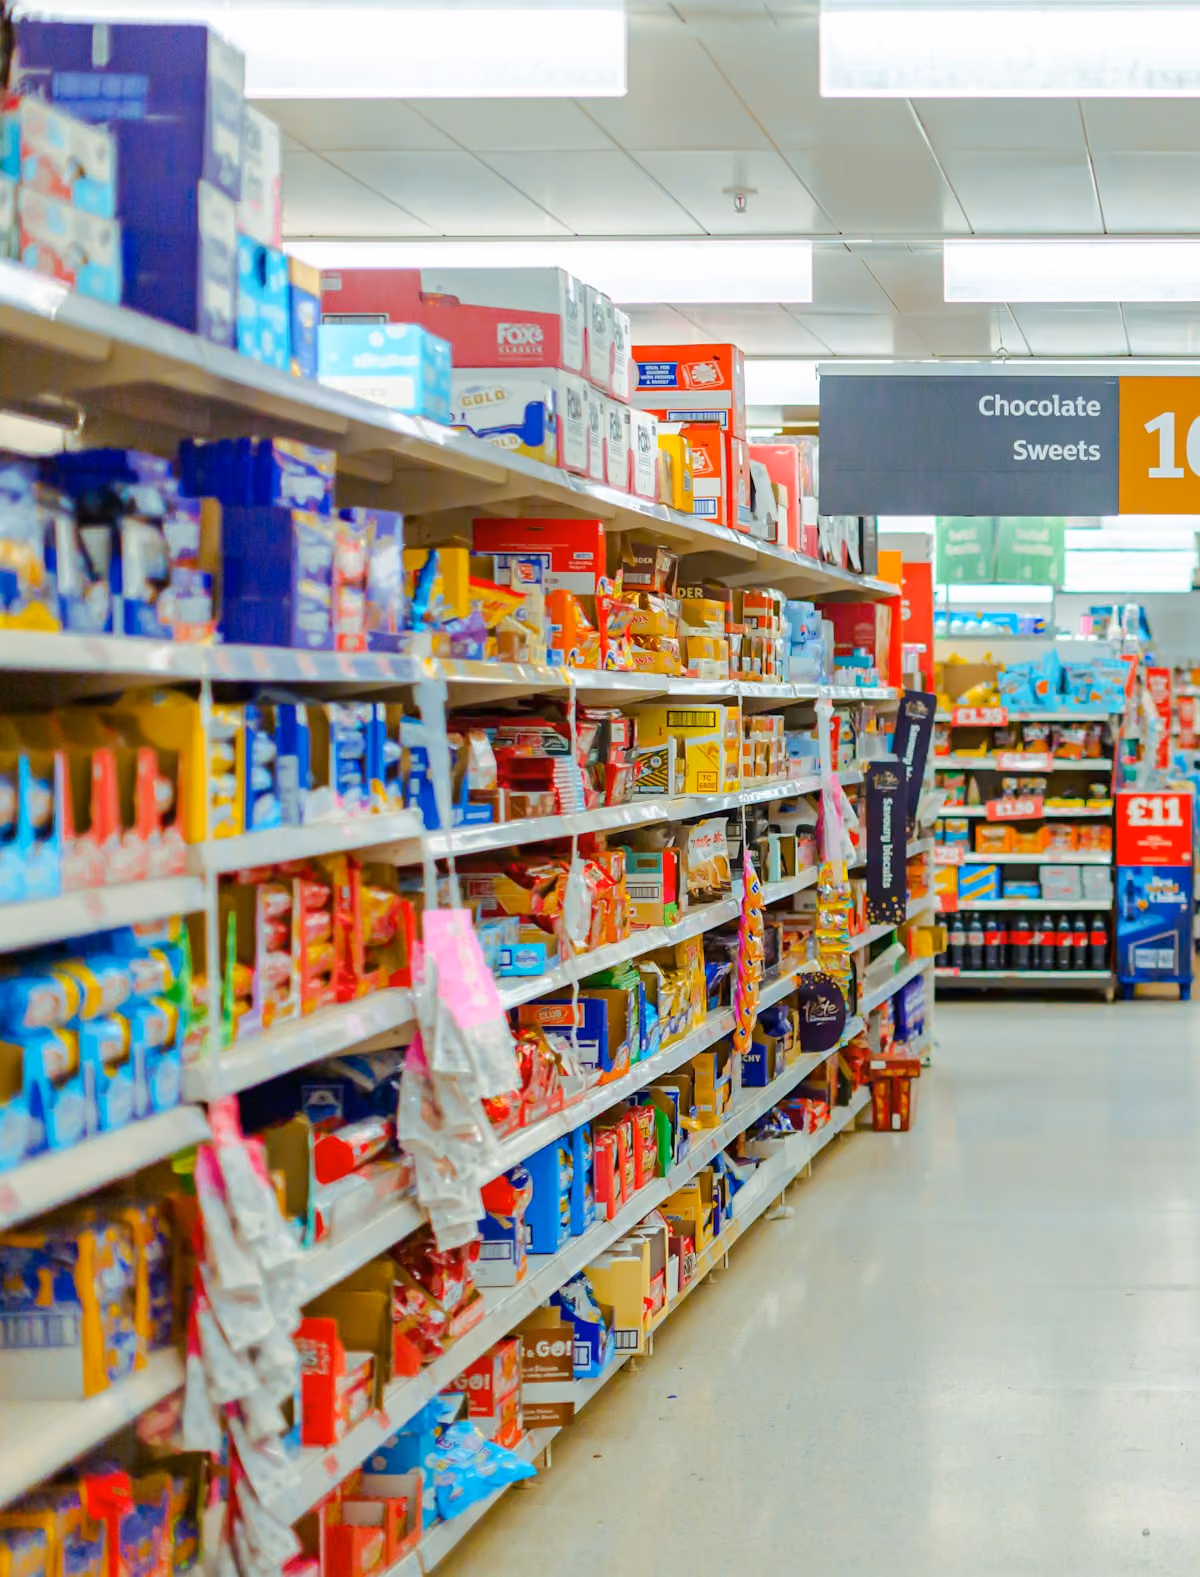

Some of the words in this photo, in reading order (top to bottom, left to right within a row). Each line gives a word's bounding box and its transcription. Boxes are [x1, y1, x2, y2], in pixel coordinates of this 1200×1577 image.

[498, 345, 543, 353] CLASSIC
[462, 389, 506, 407] GOLD
[978, 393, 1101, 417] Chocolate
[1013, 439, 1101, 462] Sweets
[677, 587, 704, 599] DER
[880, 797, 893, 843] Savoury
[1127, 797, 1183, 827] £11
[882, 843, 893, 889] biscuits
[536, 1340, 572, 1358] GO!
